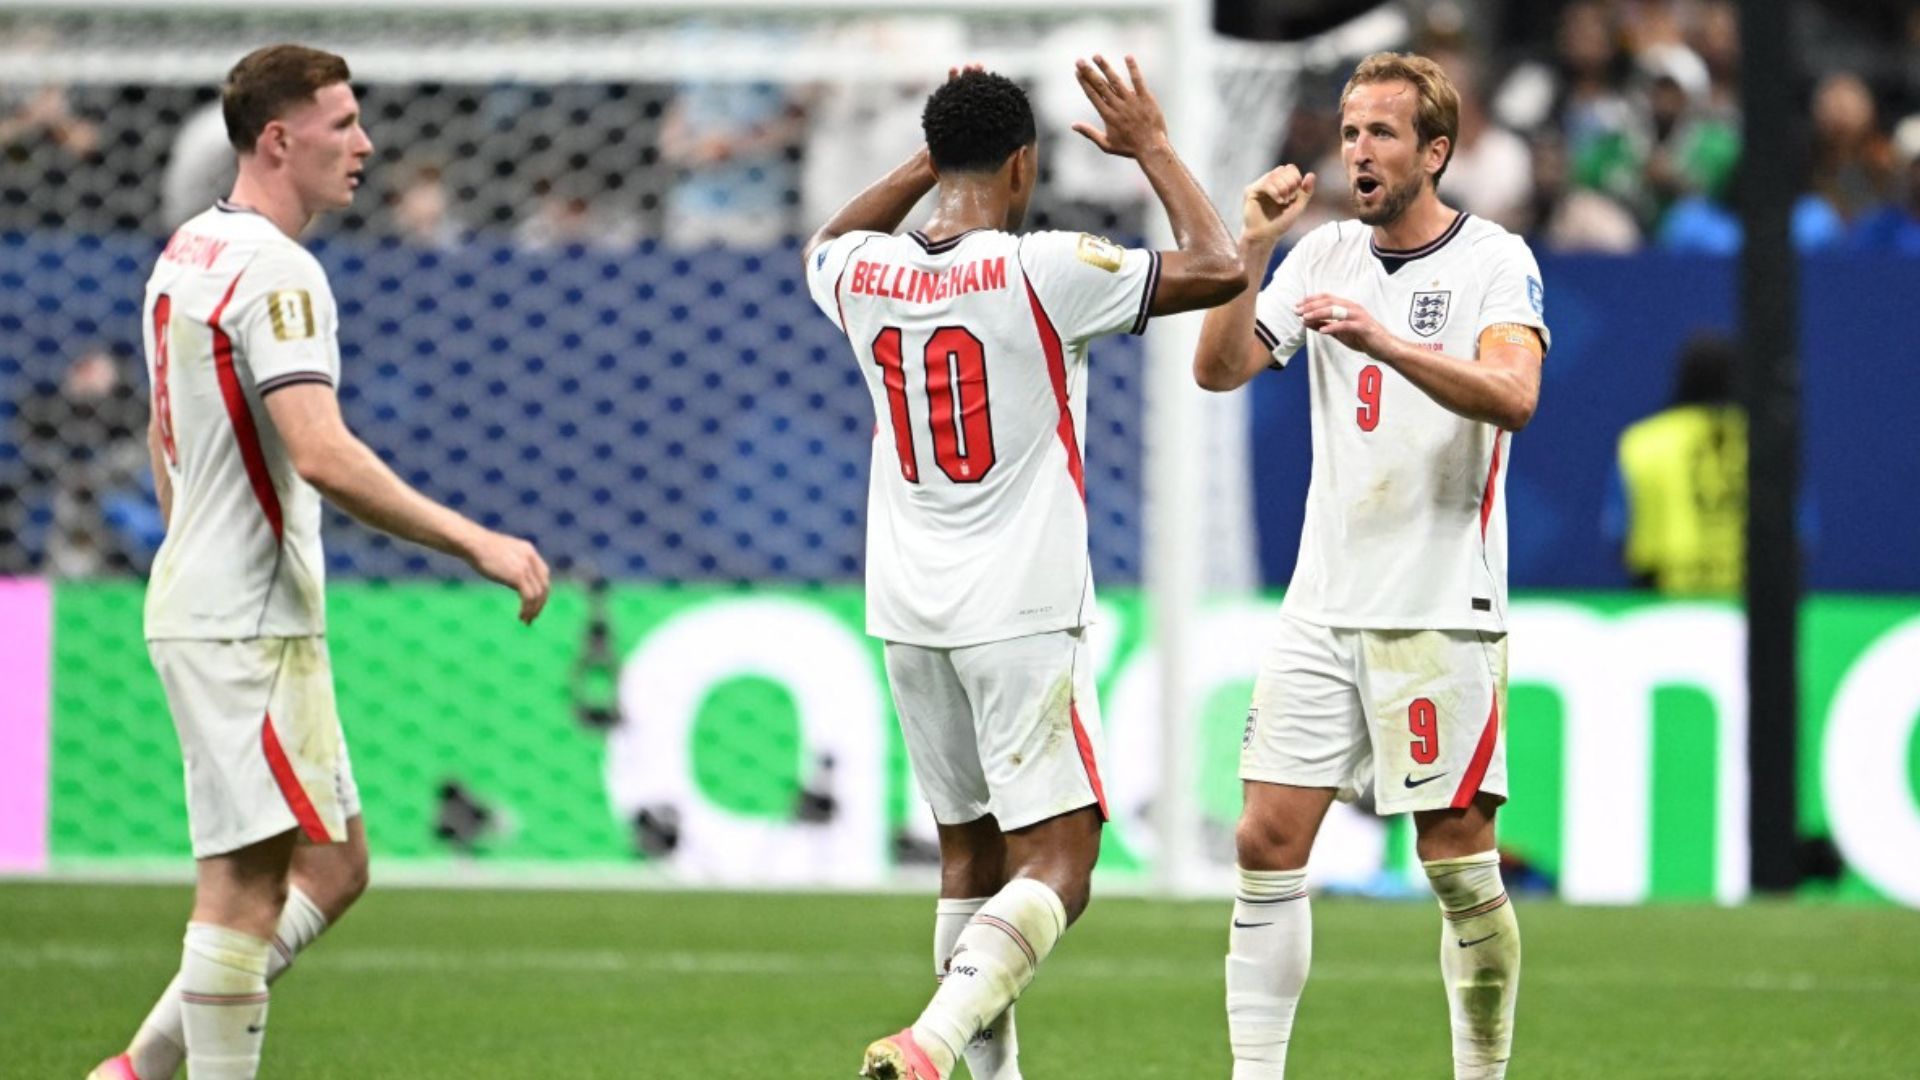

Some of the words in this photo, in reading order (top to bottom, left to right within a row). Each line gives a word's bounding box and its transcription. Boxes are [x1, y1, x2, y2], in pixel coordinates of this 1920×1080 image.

[850, 256, 1007, 304] BELLINGHAM
[872, 326, 996, 484] 10
[1357, 365, 1382, 432] 9
[1408, 697, 1439, 765] 9
